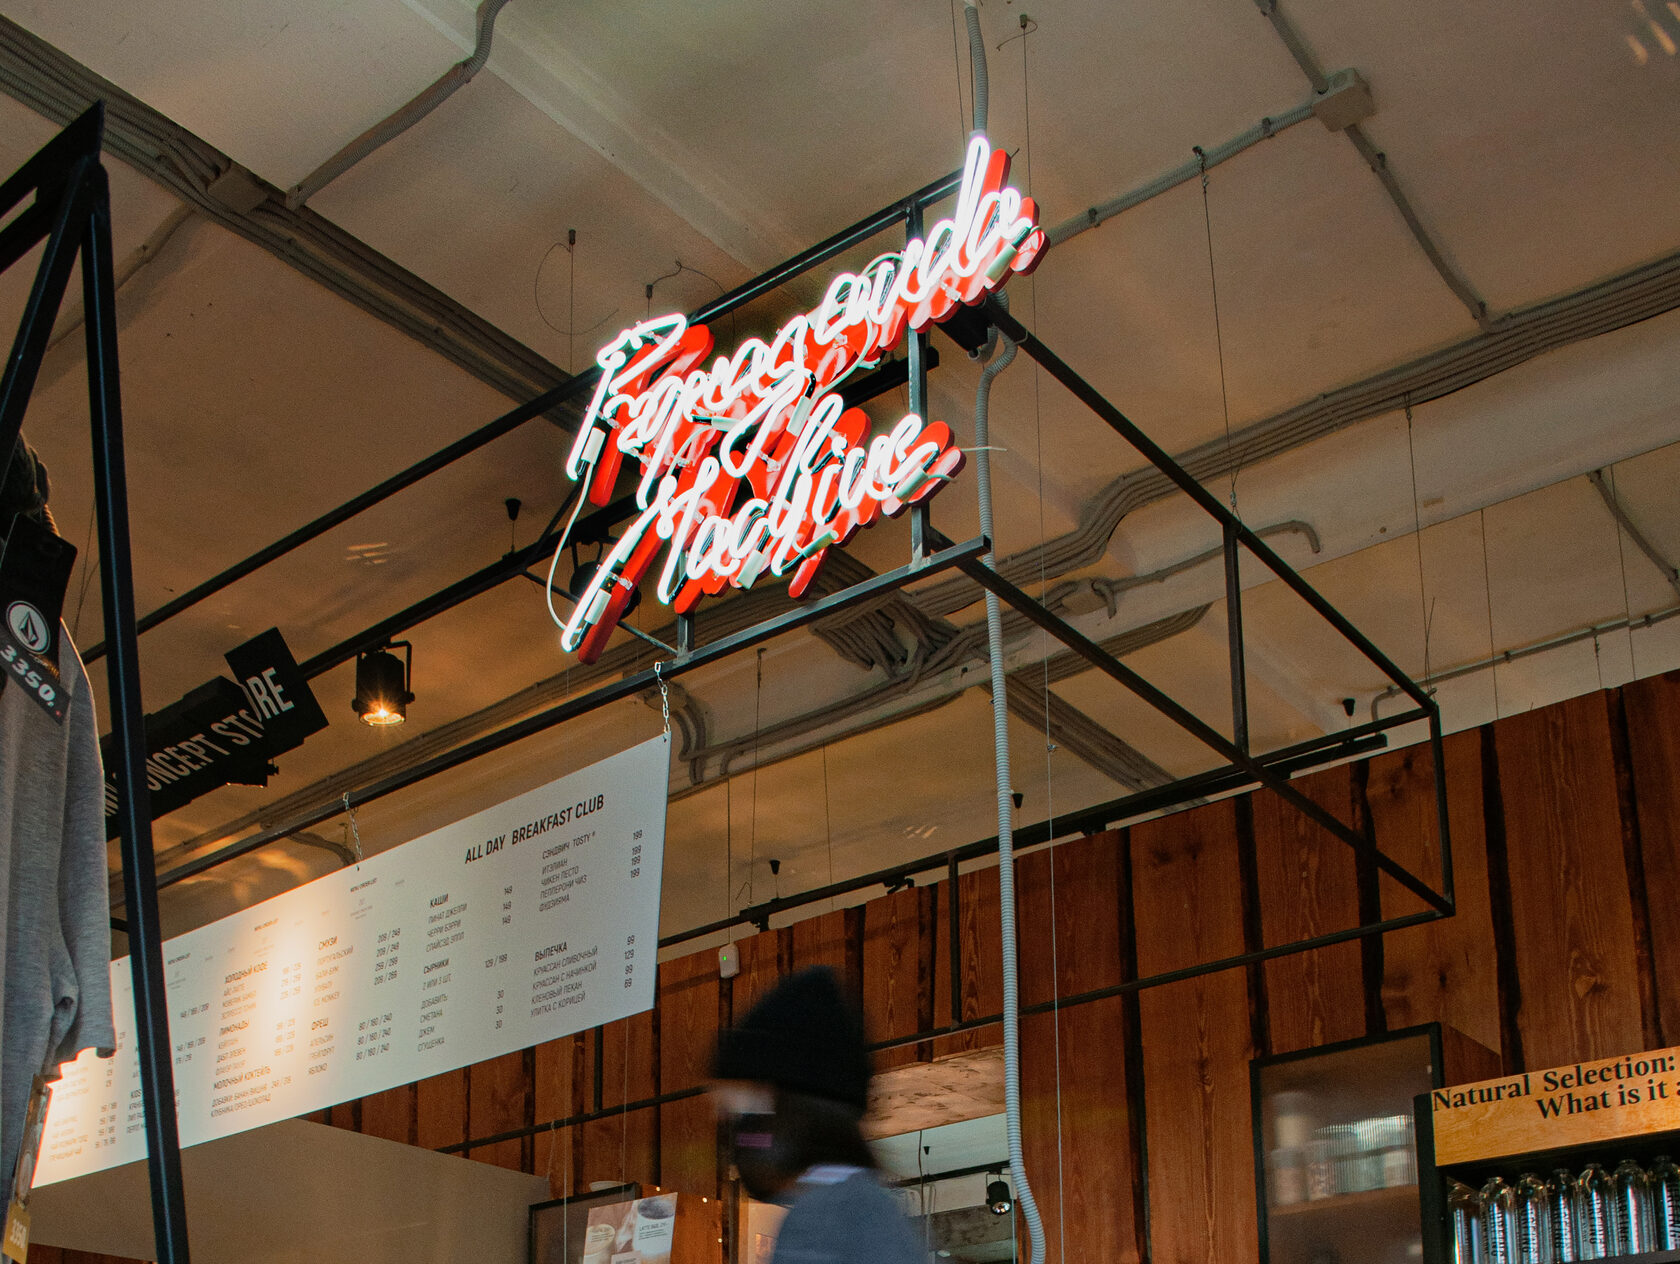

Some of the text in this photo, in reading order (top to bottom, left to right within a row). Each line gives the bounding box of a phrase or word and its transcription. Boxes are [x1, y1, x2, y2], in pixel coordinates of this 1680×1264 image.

[211, 667, 294, 745] STORE
[465, 793, 604, 865] ALL DAY BREAKFAST CLUB
[535, 941, 568, 962] ВЫПЕЧКА
[1433, 1054, 1675, 1111] Natural Selection:
[1536, 1089, 1611, 1119] What
[1618, 1084, 1640, 1107] is
[1647, 1078, 1669, 1101] it
